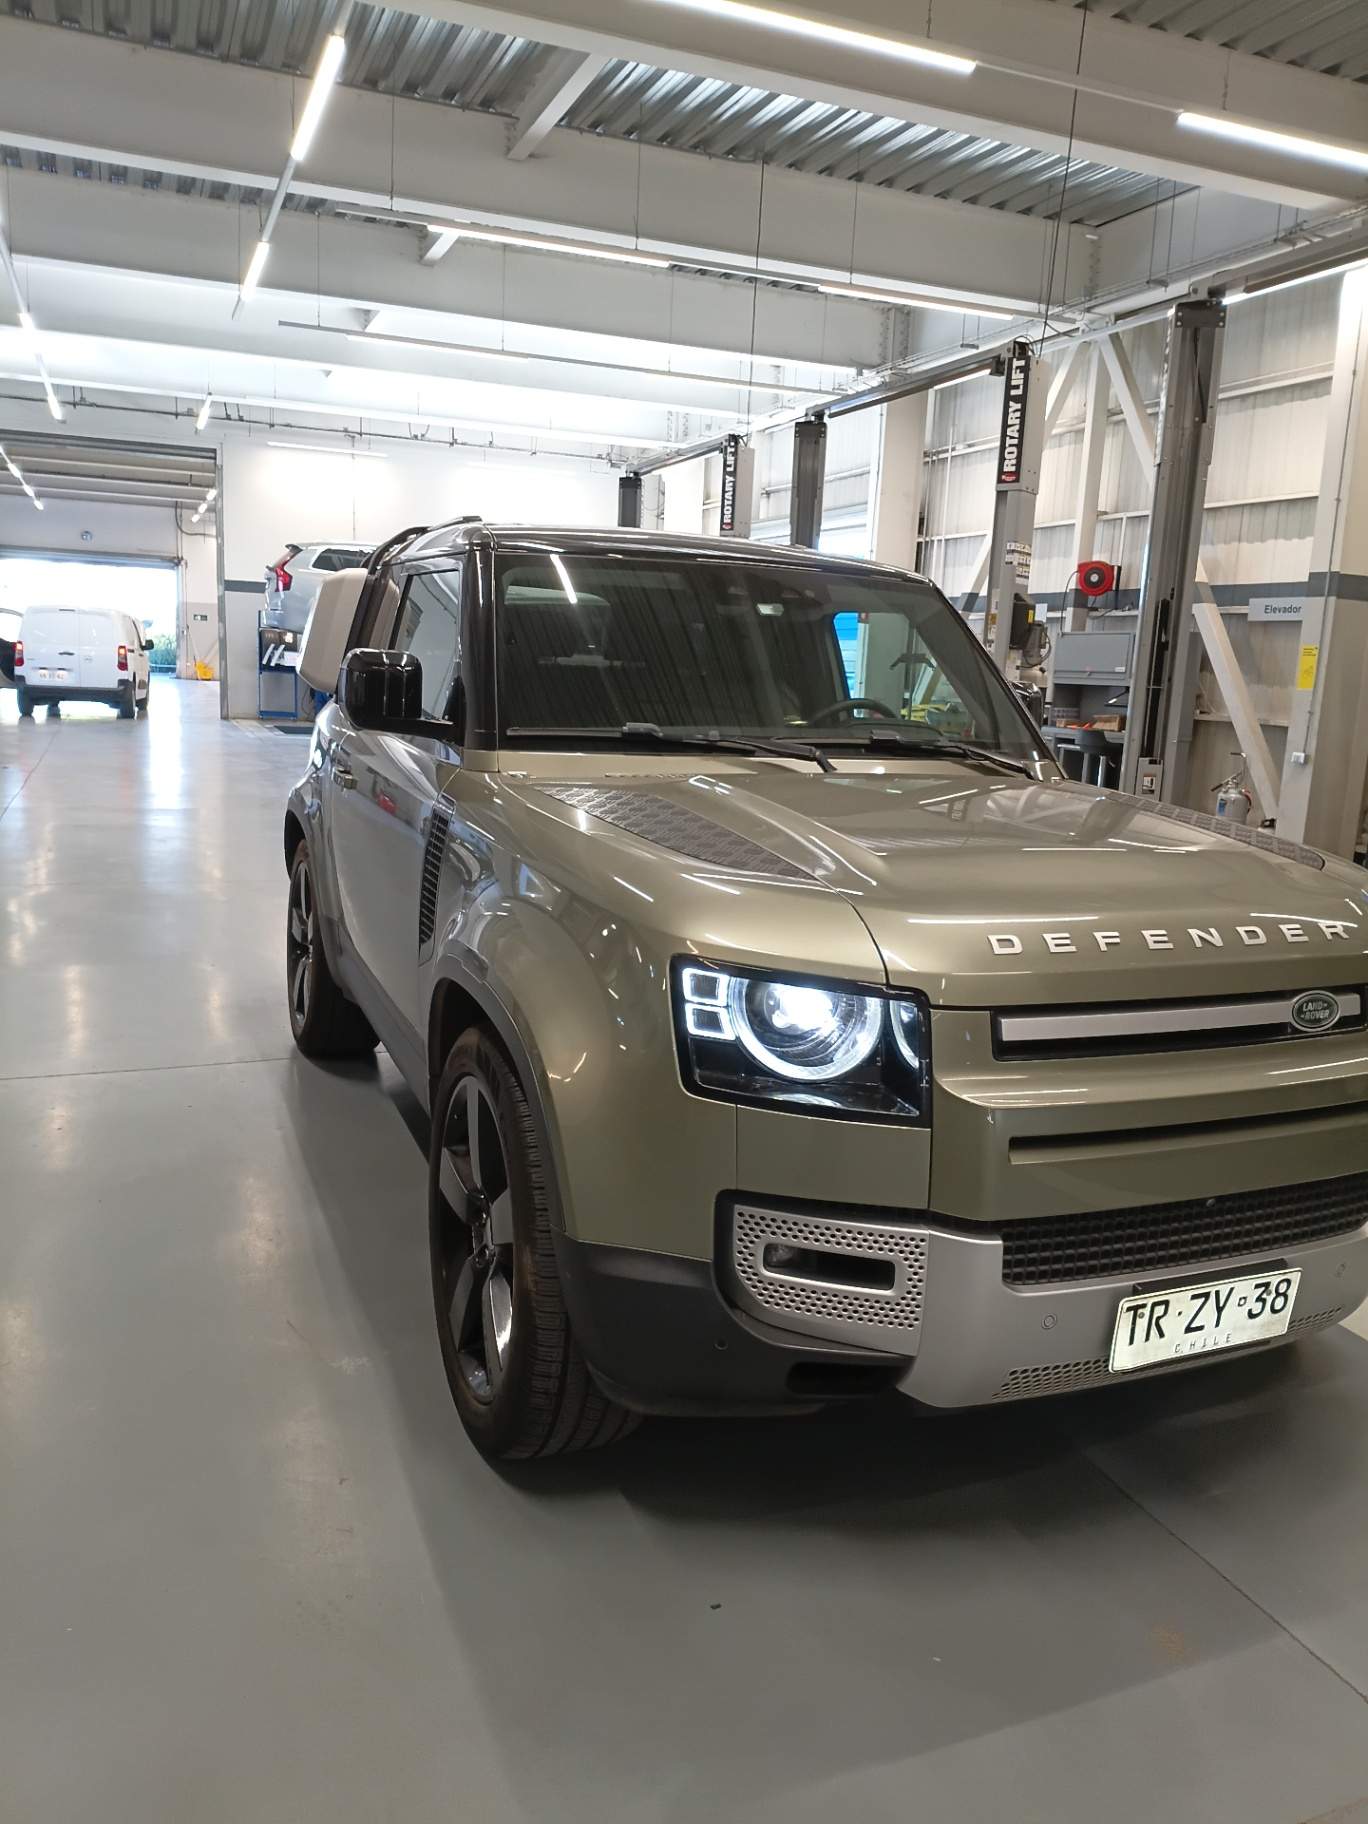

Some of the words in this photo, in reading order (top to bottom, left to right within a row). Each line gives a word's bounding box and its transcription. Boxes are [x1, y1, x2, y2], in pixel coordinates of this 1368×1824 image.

[1010, 358, 1026, 396] LIFT
[1003, 401, 1022, 472] ROTARY
[723, 475, 735, 523] ROTARY
[1264, 604, 1302, 614] Elevador
[987, 921, 1351, 955] DEFENDER
[1302, 1001, 1323, 1012] LAND
[1304, 1011, 1330, 1020] ROVER
[1174, 1332, 1233, 1354] CHILE
